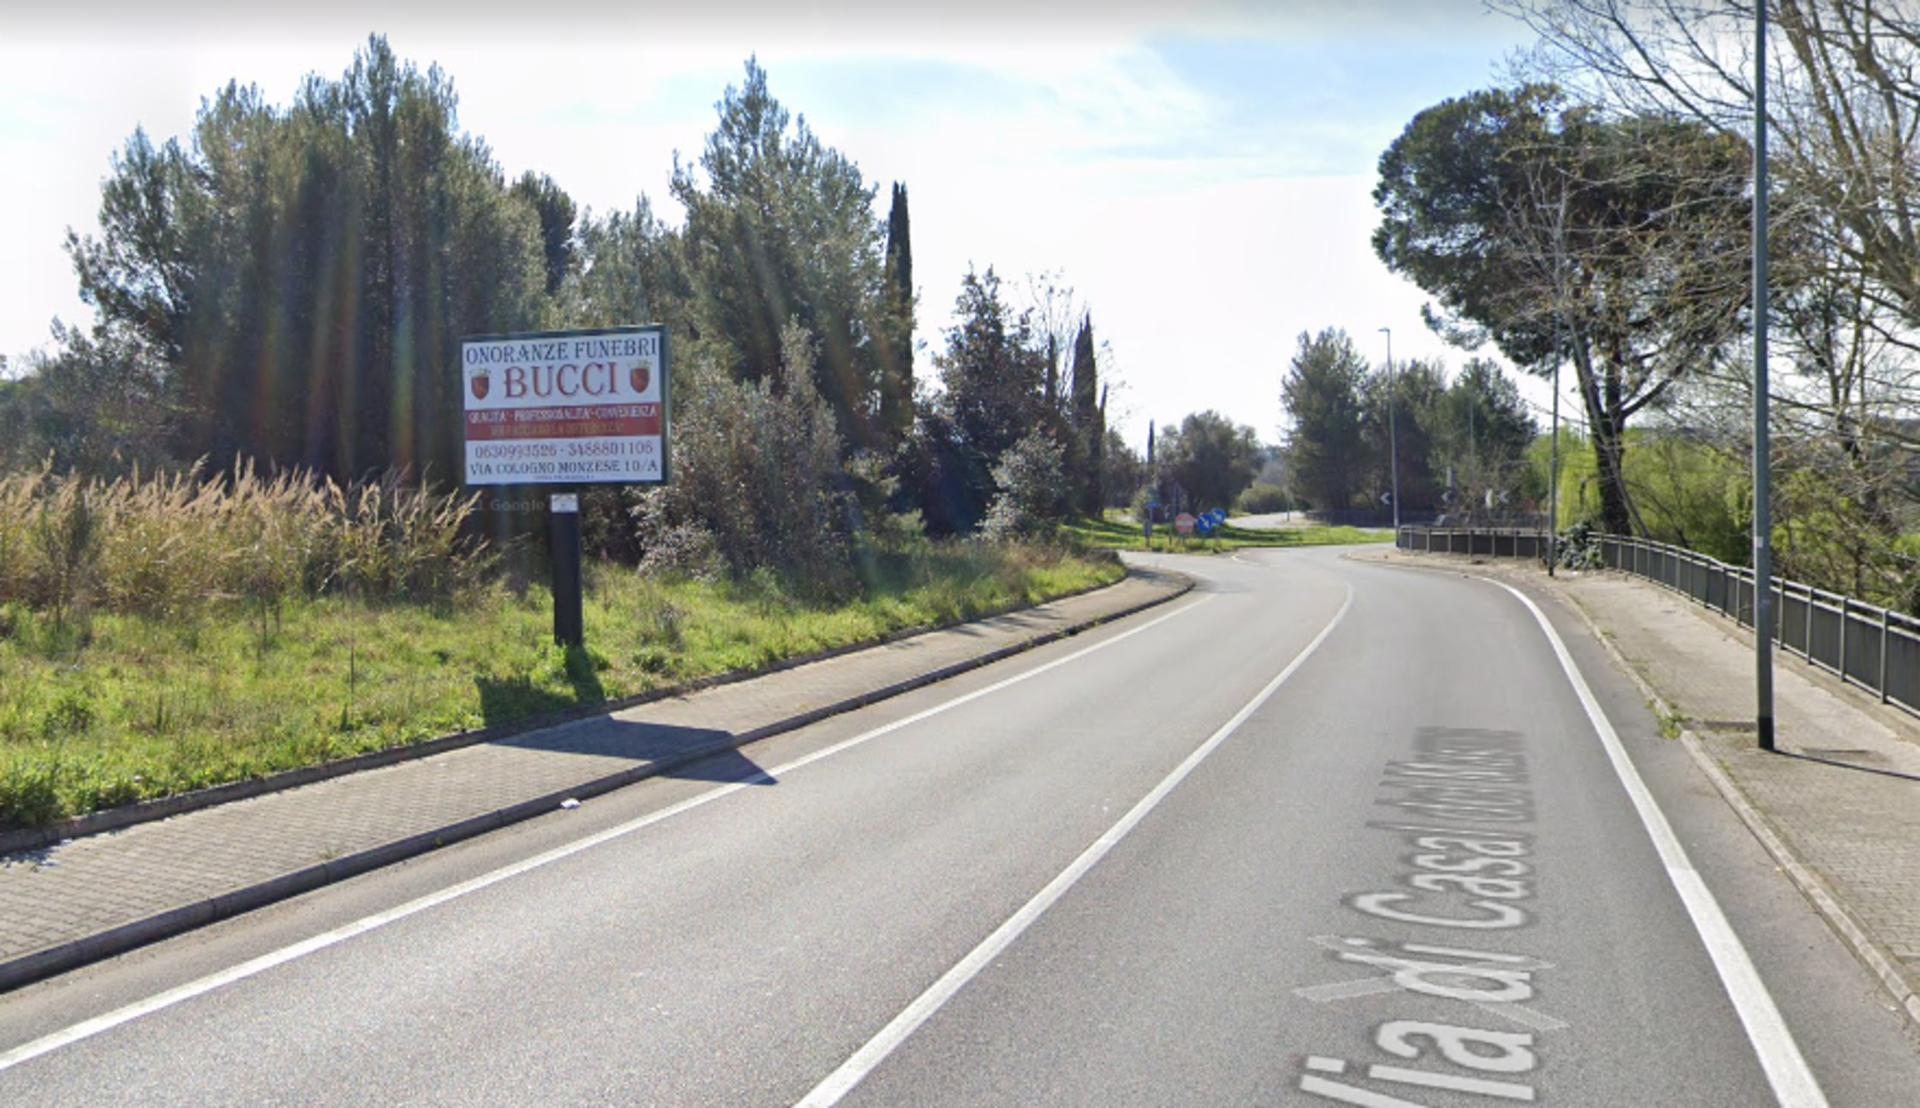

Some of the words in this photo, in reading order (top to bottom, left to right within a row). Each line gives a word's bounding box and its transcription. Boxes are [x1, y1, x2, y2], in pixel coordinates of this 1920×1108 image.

[466, 343, 568, 364] ONORANZE
[575, 337, 657, 359] FUNEBRI
[504, 361, 618, 399] BUCCI
[470, 462, 492, 476] VIA
[496, 461, 555, 475] COLOGNO
[558, 459, 621, 473] MONZESE
[624, 458, 658, 473] 10/A
